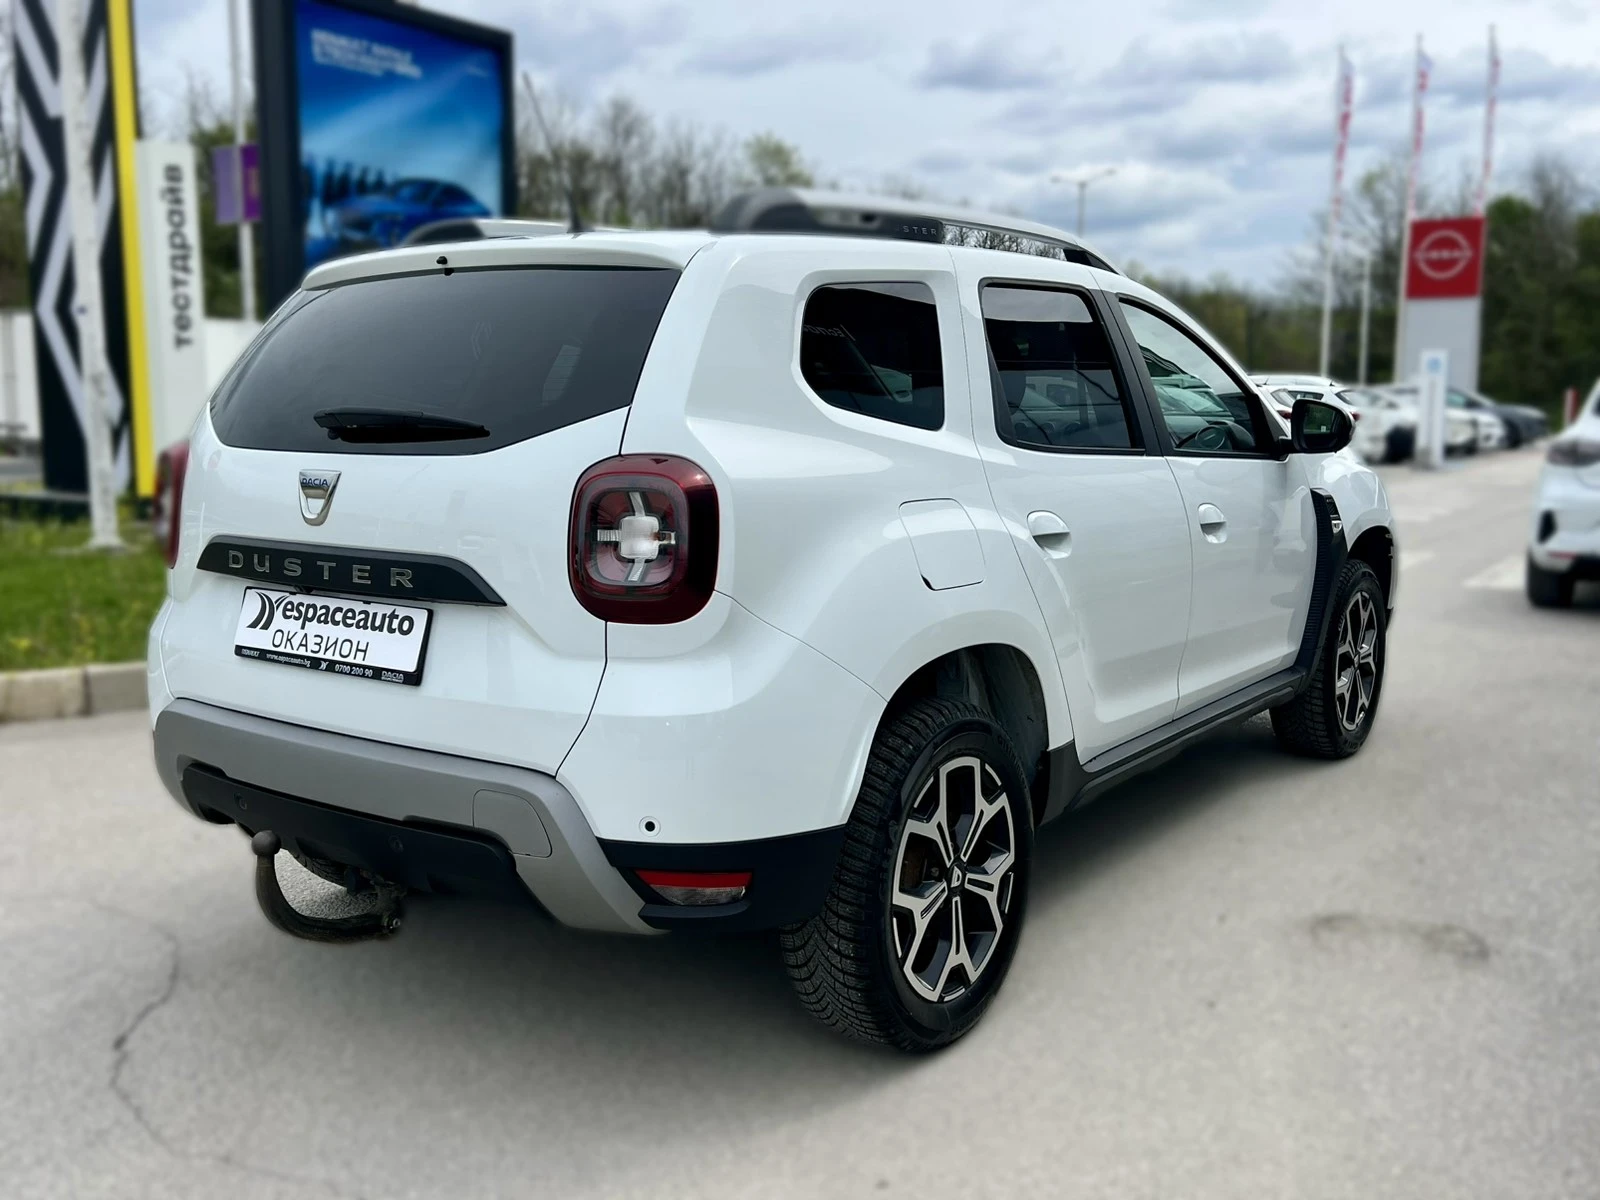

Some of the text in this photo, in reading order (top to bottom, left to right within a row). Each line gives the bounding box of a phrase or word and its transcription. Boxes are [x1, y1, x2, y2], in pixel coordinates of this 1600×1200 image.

[301, 477, 328, 486] DACIA
[228, 550, 413, 588] DUSTER
[281, 600, 415, 636] espaceauto
[271, 629, 370, 661] ОКАЗИОН
[334, 663, 351, 674] 0700
[351, 666, 364, 676] 200
[364, 668, 374, 678] 90
[381, 670, 404, 680] DACIA
